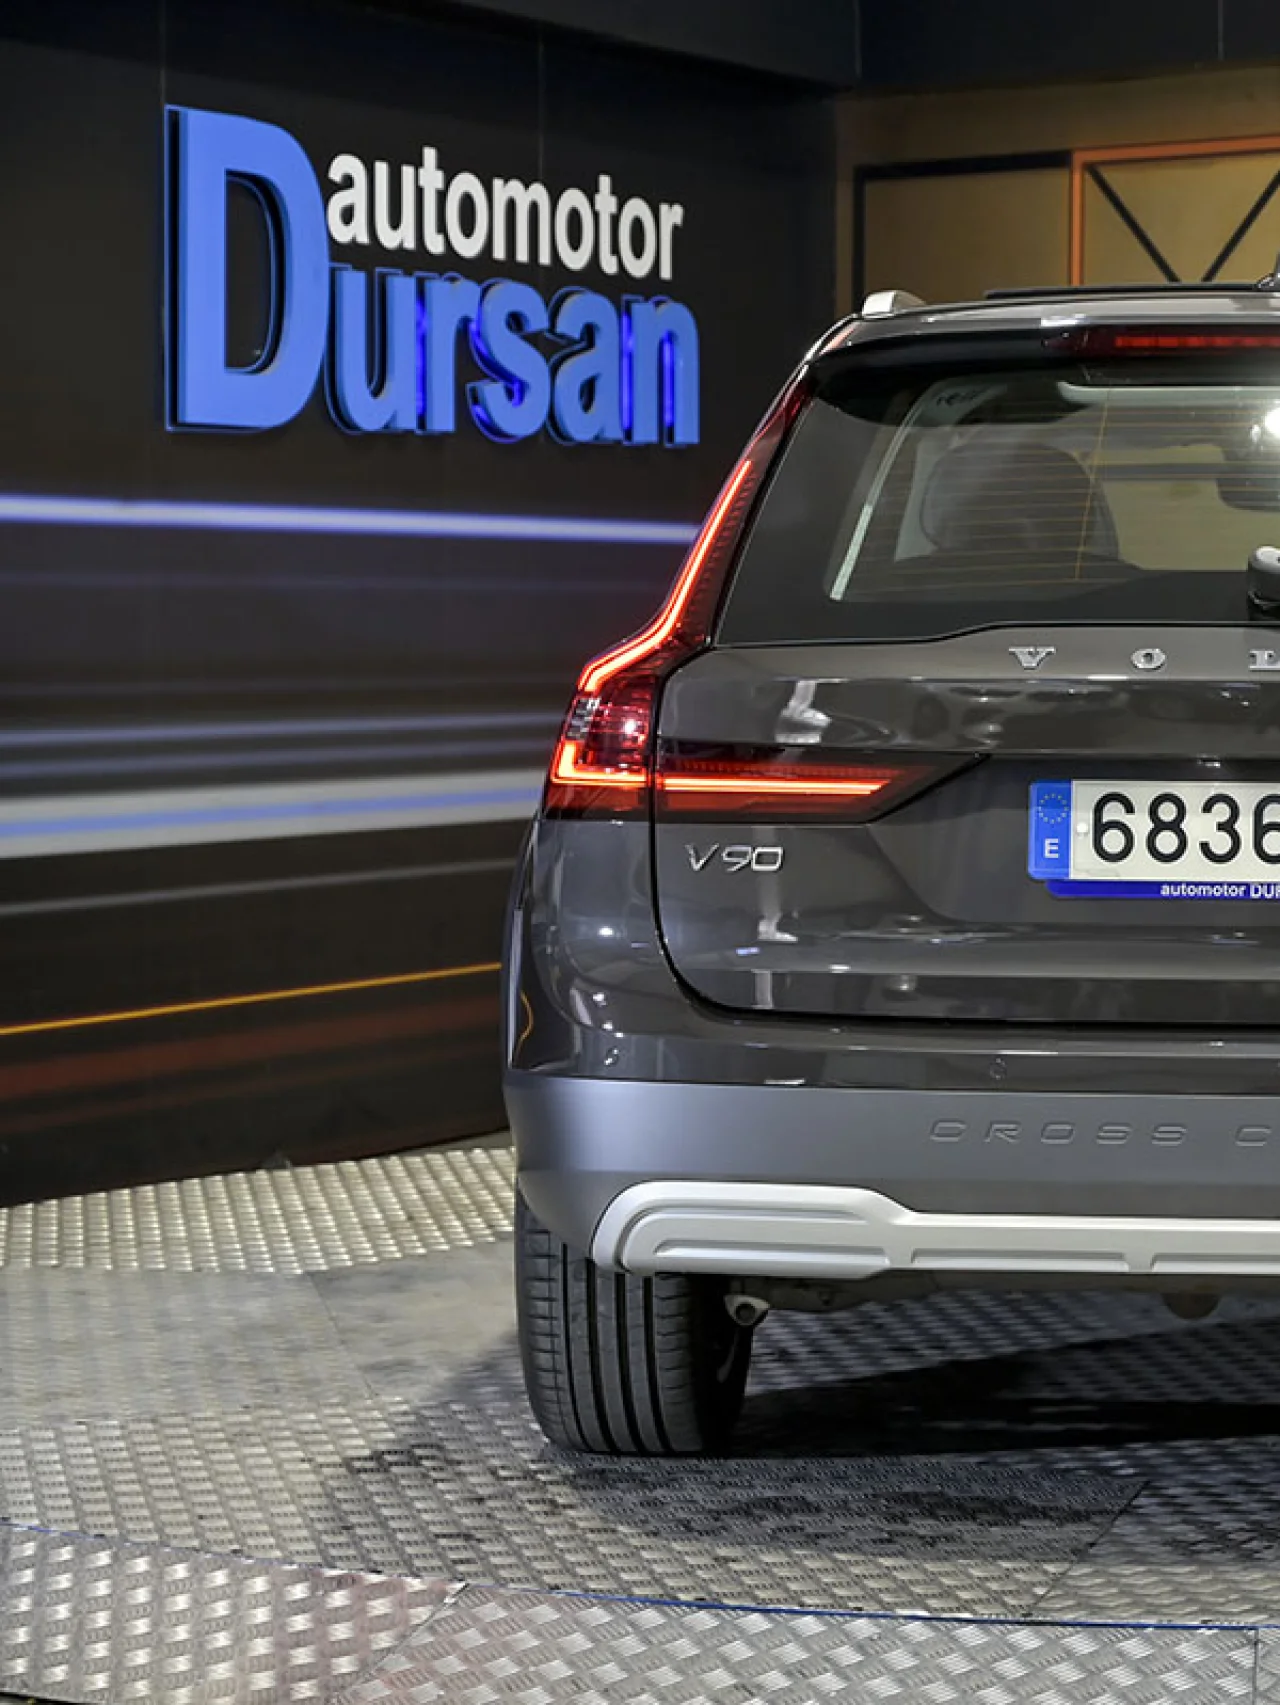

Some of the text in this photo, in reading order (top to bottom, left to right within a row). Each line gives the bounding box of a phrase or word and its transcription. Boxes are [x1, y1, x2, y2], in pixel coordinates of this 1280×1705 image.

[327, 146, 683, 280] automotor
[164, 104, 700, 447] Dursan
[684, 842, 784, 872] V90
[1044, 838, 1060, 859] E
[1160, 882, 1247, 899] automotor
[928, 1118, 1188, 1148] CROSS
